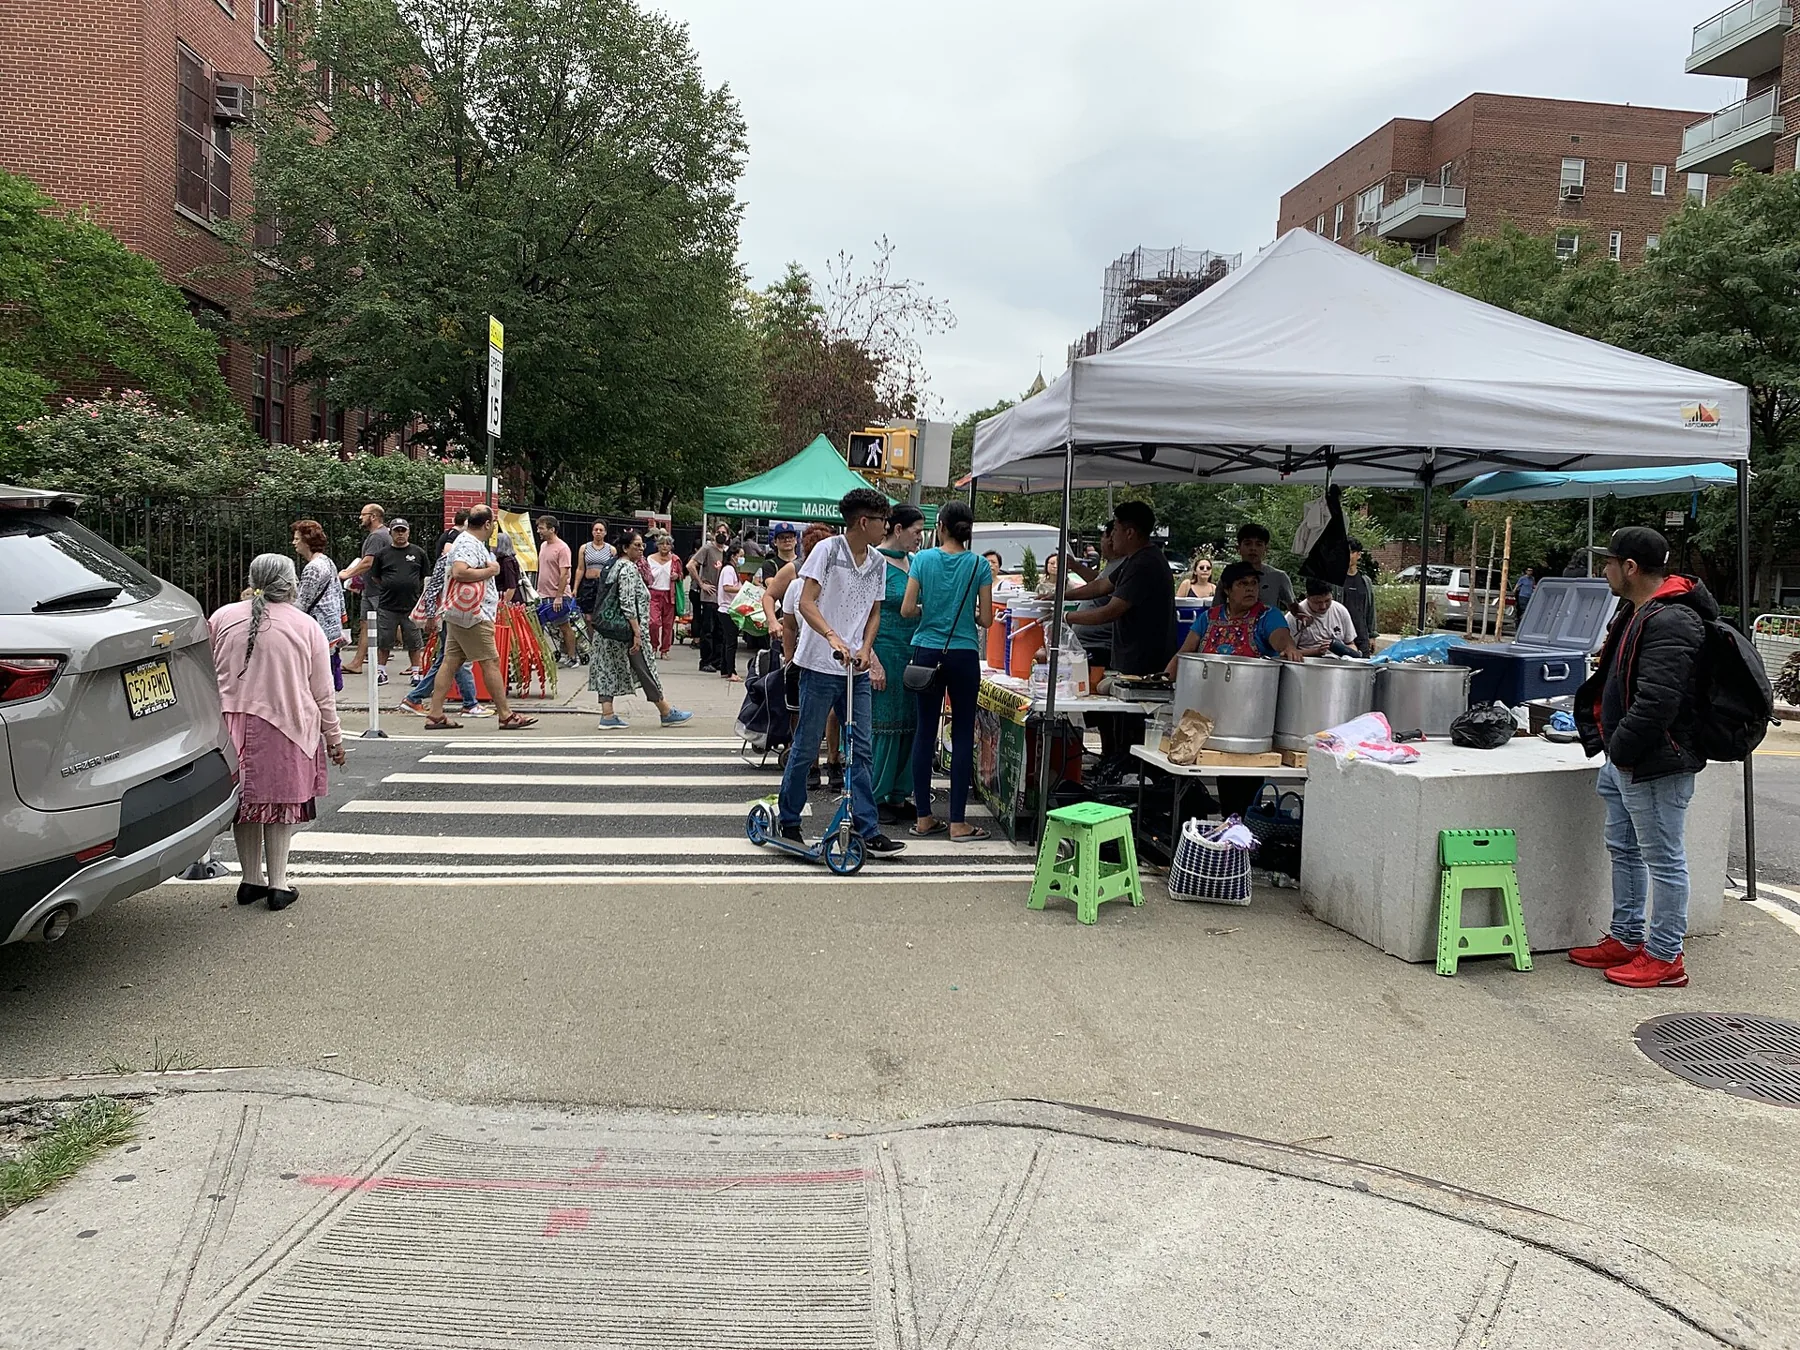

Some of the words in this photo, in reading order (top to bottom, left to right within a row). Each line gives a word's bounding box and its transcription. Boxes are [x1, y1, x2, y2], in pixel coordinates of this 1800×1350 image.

[490, 355, 502, 373] SPEED
[490, 376, 501, 392] LIMIT
[490, 395, 499, 426] 15
[725, 498, 773, 512] GROW
[802, 503, 843, 517] MARKE
[61, 756, 102, 778] BLAZER
